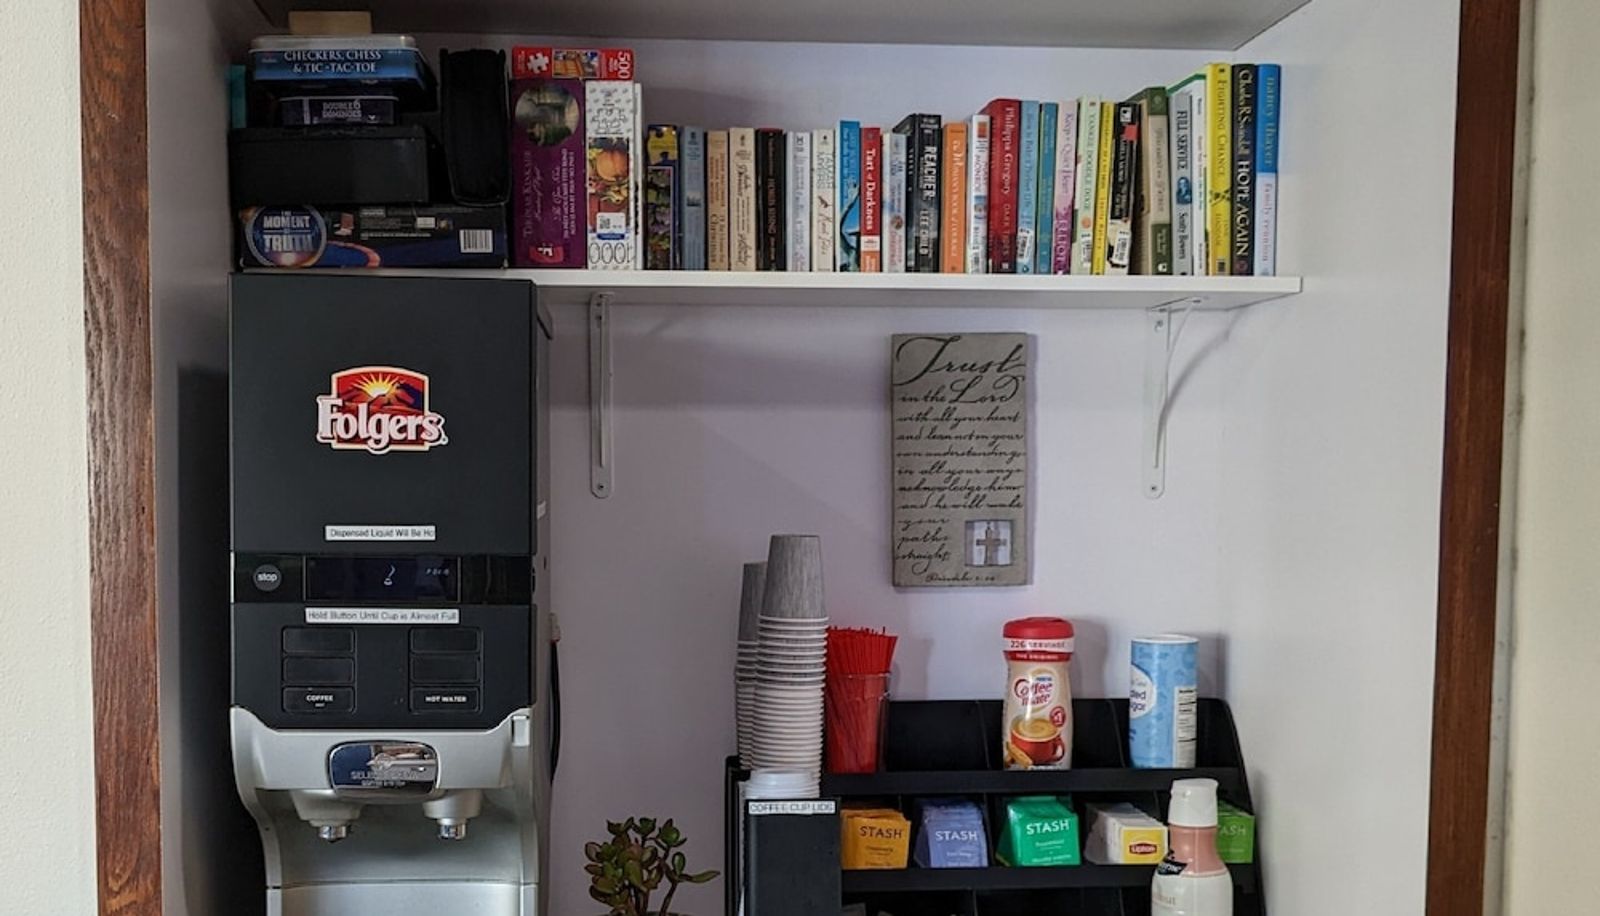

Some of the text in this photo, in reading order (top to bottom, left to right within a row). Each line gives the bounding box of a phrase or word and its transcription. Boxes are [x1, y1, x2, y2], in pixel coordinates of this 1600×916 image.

[284, 50, 344, 62] CHECKERS,
[346, 50, 382, 61] CHESS
[293, 62, 302, 73] &
[617, 51, 631, 79] 500
[1062, 113, 1075, 136] Keep
[1217, 79, 1229, 177] FIGHTING CHANCE
[1262, 76, 1278, 167] nancy thayer
[1001, 106, 1015, 195] Philippa Gregory
[1176, 109, 1189, 171] FULL SERVICE
[866, 148, 877, 171] Tart
[1061, 143, 1073, 167] Quiet
[1084, 150, 1094, 187] DOODLE
[1062, 169, 1073, 193] Heart
[866, 181, 878, 231] Darkness
[1236, 160, 1251, 257] HOPE AGAIN
[263, 215, 310, 229] MOMENT
[919, 209, 931, 256] LEE CHILD
[1262, 183, 1274, 261] family reunion
[263, 234, 313, 253] TRUTH
[893, 335, 1026, 386] Trust
[317, 397, 441, 450] Folgers
[896, 405, 1020, 431] with all your heart
[896, 425, 924, 441] and
[926, 424, 952, 441] lean
[953, 429, 976, 441] not
[987, 433, 1024, 447] your
[897, 459, 1024, 485] in all your ways
[896, 475, 1025, 500] acknowledge him
[898, 491, 1024, 510] and he will make
[329, 527, 369, 538] Dispensed
[370, 527, 394, 538] Liquid
[396, 527, 409, 537] Will
[411, 527, 422, 537] Be
[897, 518, 950, 533] your
[257, 573, 278, 583] stop
[308, 610, 328, 620] Hold
[330, 610, 358, 620] Button
[359, 610, 379, 620] Until
[381, 611, 399, 622] Cup
[410, 611, 439, 621] Almost
[441, 611, 457, 621] Full
[1010, 640, 1026, 649] 226
[306, 694, 334, 702] COFFEE
[425, 695, 467, 703] HOT WATER
[1014, 678, 1053, 699] Coffee
[750, 803, 785, 813] COFFEE
[790, 803, 811, 812] CUP
[859, 825, 903, 840] STASH
[935, 830, 978, 841] STASH
[1026, 819, 1070, 836] STASH
[1219, 825, 1247, 837] ASH
[1130, 844, 1156, 855] Lipton
